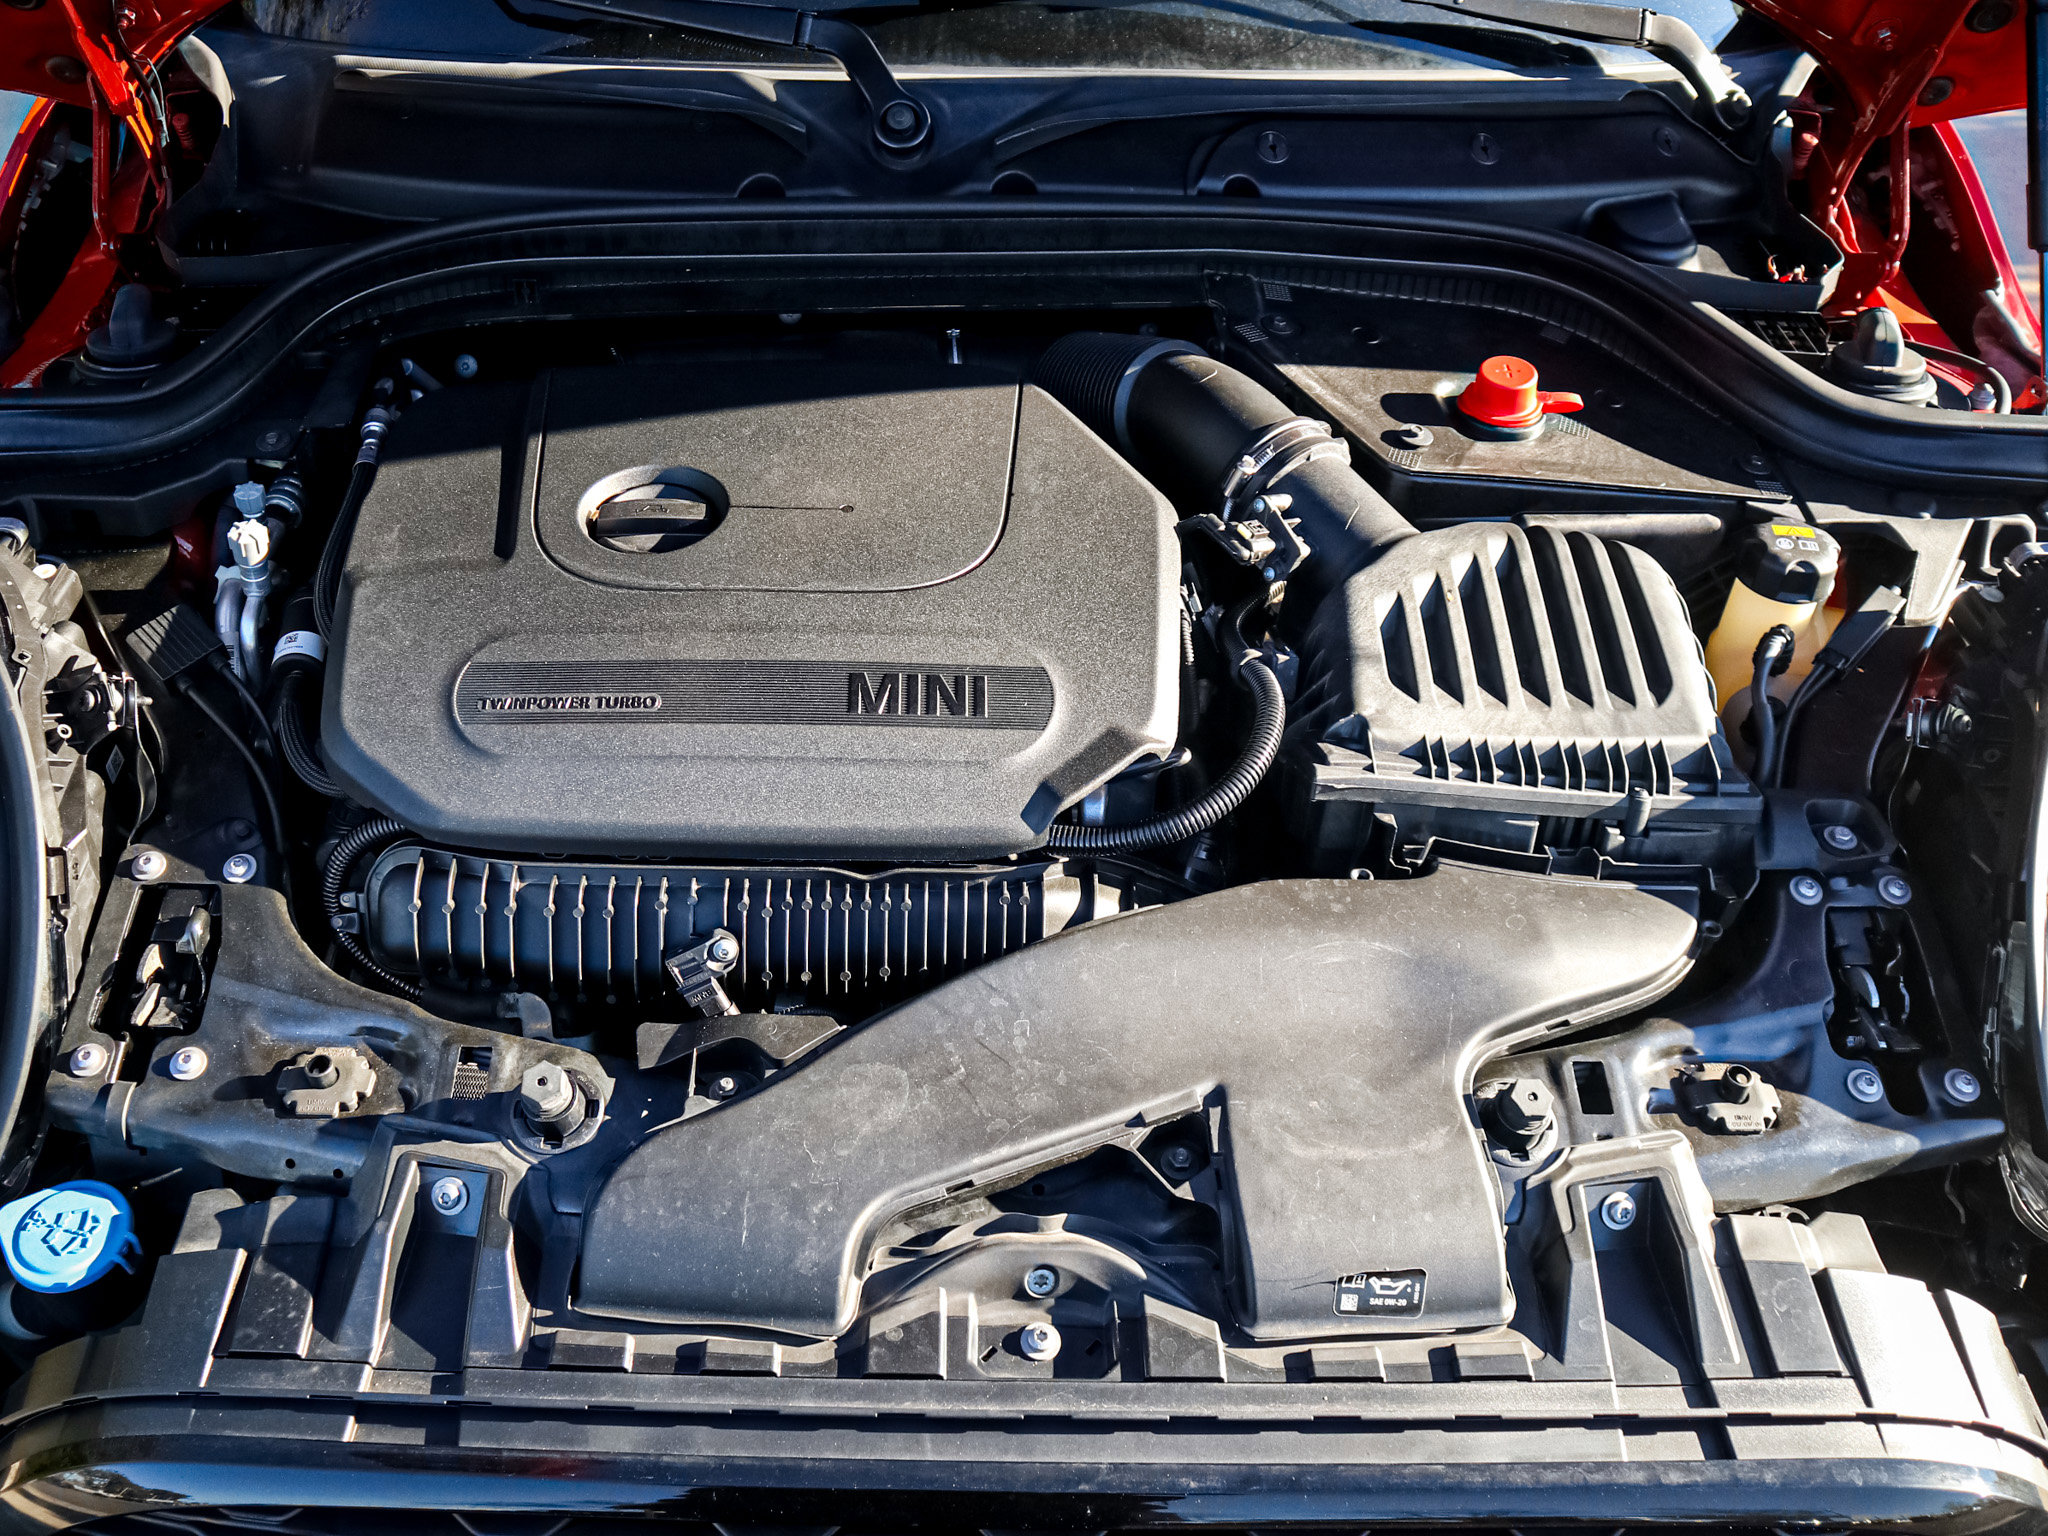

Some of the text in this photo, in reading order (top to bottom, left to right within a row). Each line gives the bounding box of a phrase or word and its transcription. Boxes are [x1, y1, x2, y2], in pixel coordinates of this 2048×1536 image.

[480, 695, 658, 710] TWINPOWER TURBO
[848, 672, 989, 719] MINI
[1369, 1297, 1408, 1307] SAE 0W-20
